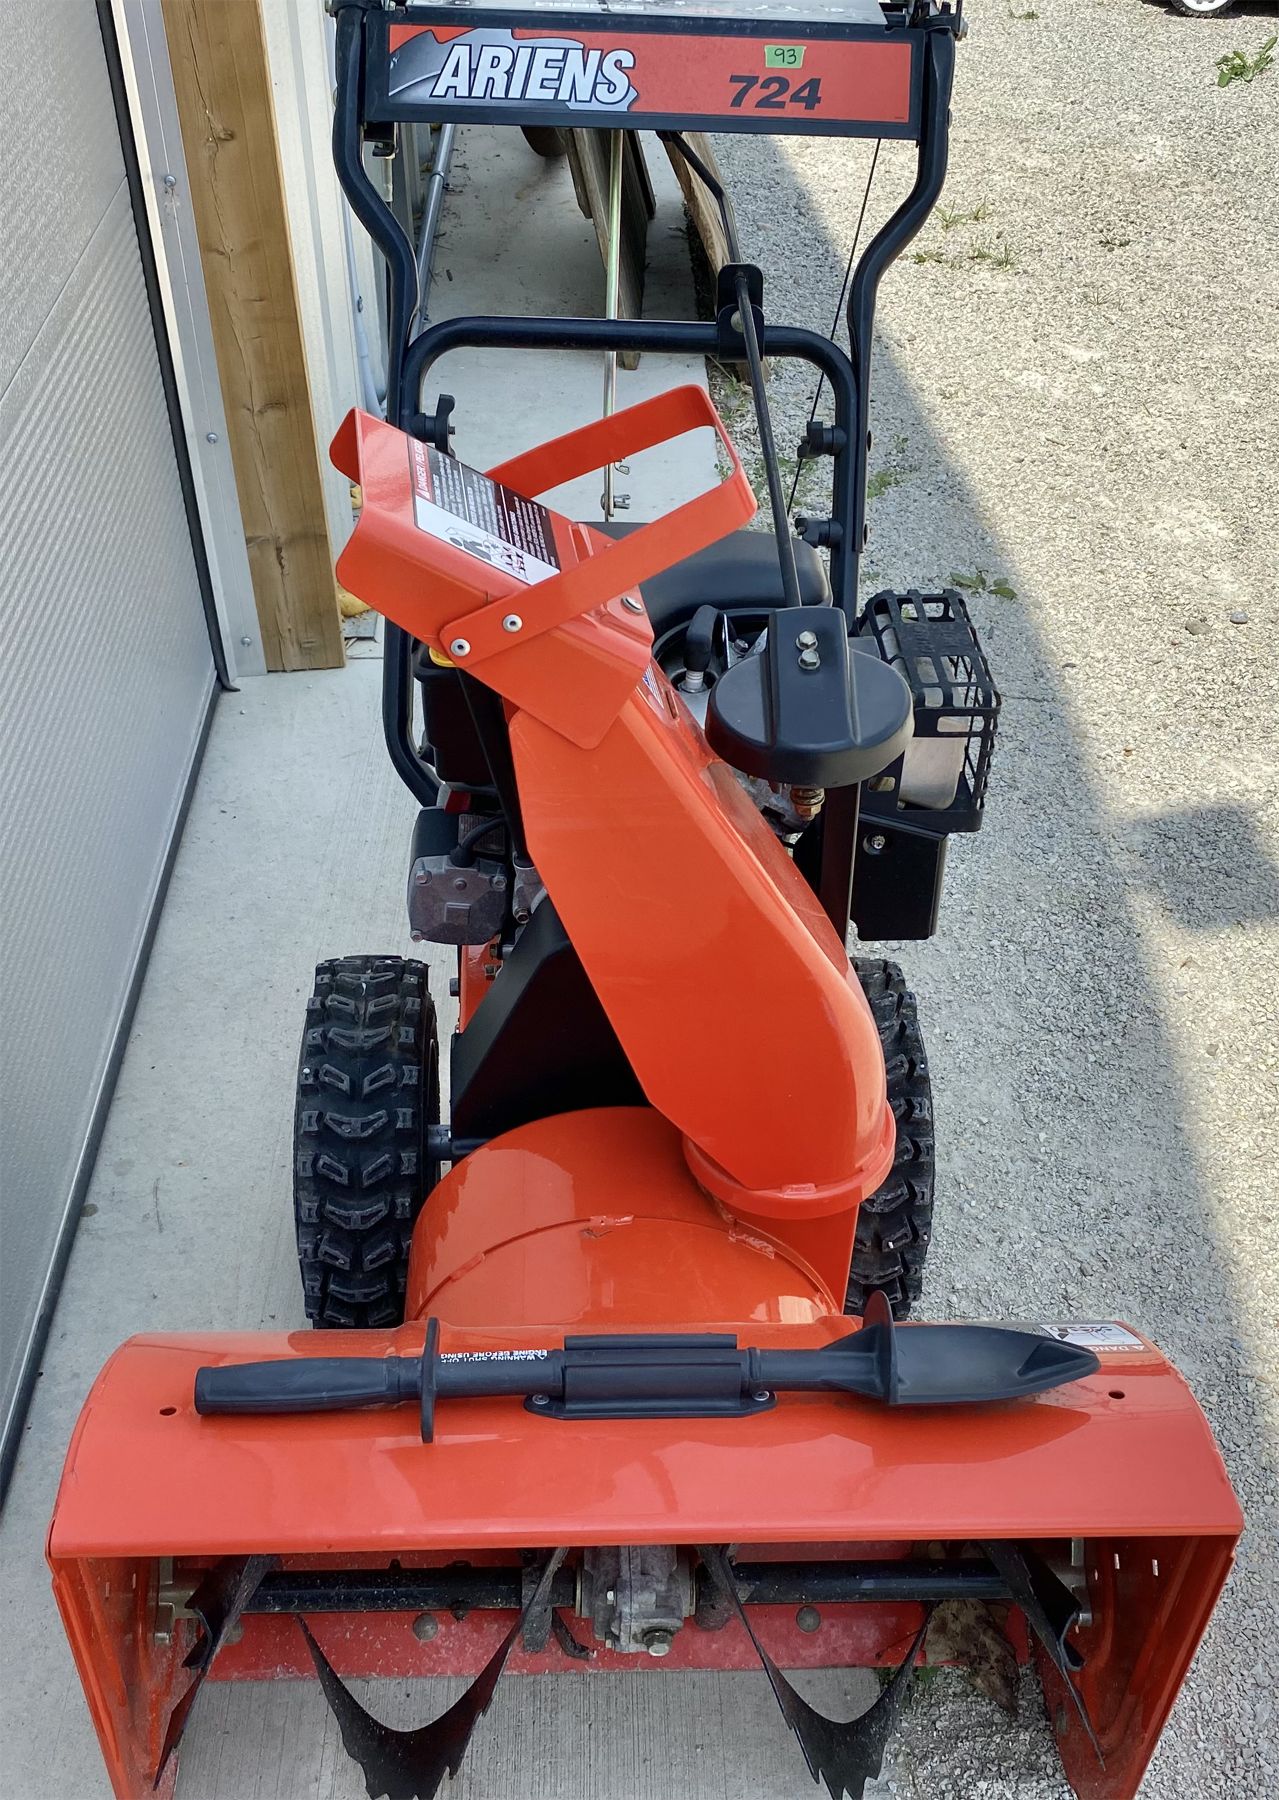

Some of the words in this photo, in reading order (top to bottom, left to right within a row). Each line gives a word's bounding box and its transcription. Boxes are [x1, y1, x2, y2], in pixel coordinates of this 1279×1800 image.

[429, 43, 636, 105] ARIENS
[774, 48, 797, 65] 93
[729, 75, 822, 110] 724
